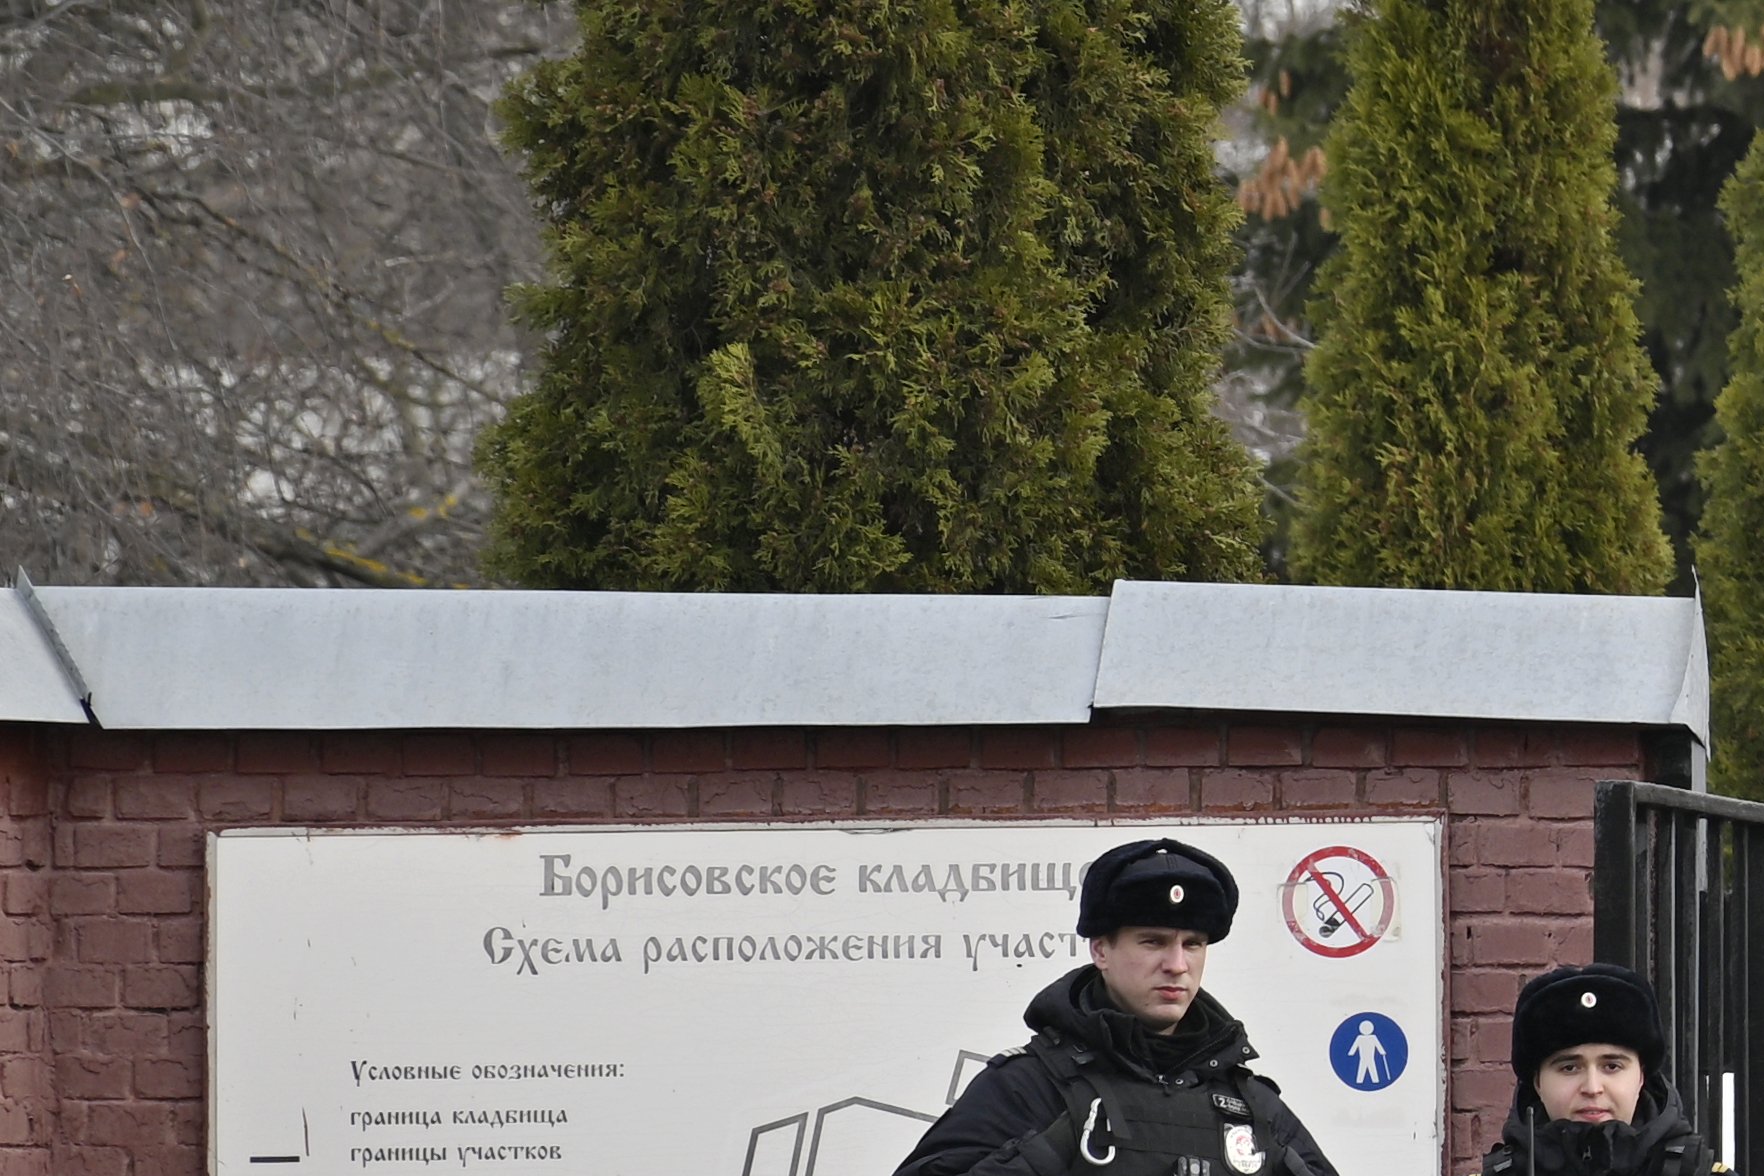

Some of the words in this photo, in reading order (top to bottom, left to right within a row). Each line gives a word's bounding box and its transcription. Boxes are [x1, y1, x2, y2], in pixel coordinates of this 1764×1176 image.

[539, 854, 837, 910] Борисовское
[483, 925, 622, 976] Схема
[643, 933, 942, 975] расположения
[963, 932, 1087, 972] участ
[350, 1060, 461, 1088] Условные
[471, 1063, 625, 1081] обозначения:
[350, 1109, 442, 1131] граница
[452, 1109, 568, 1129] кладбища
[350, 1145, 447, 1168] границы
[457, 1145, 562, 1167] участков
